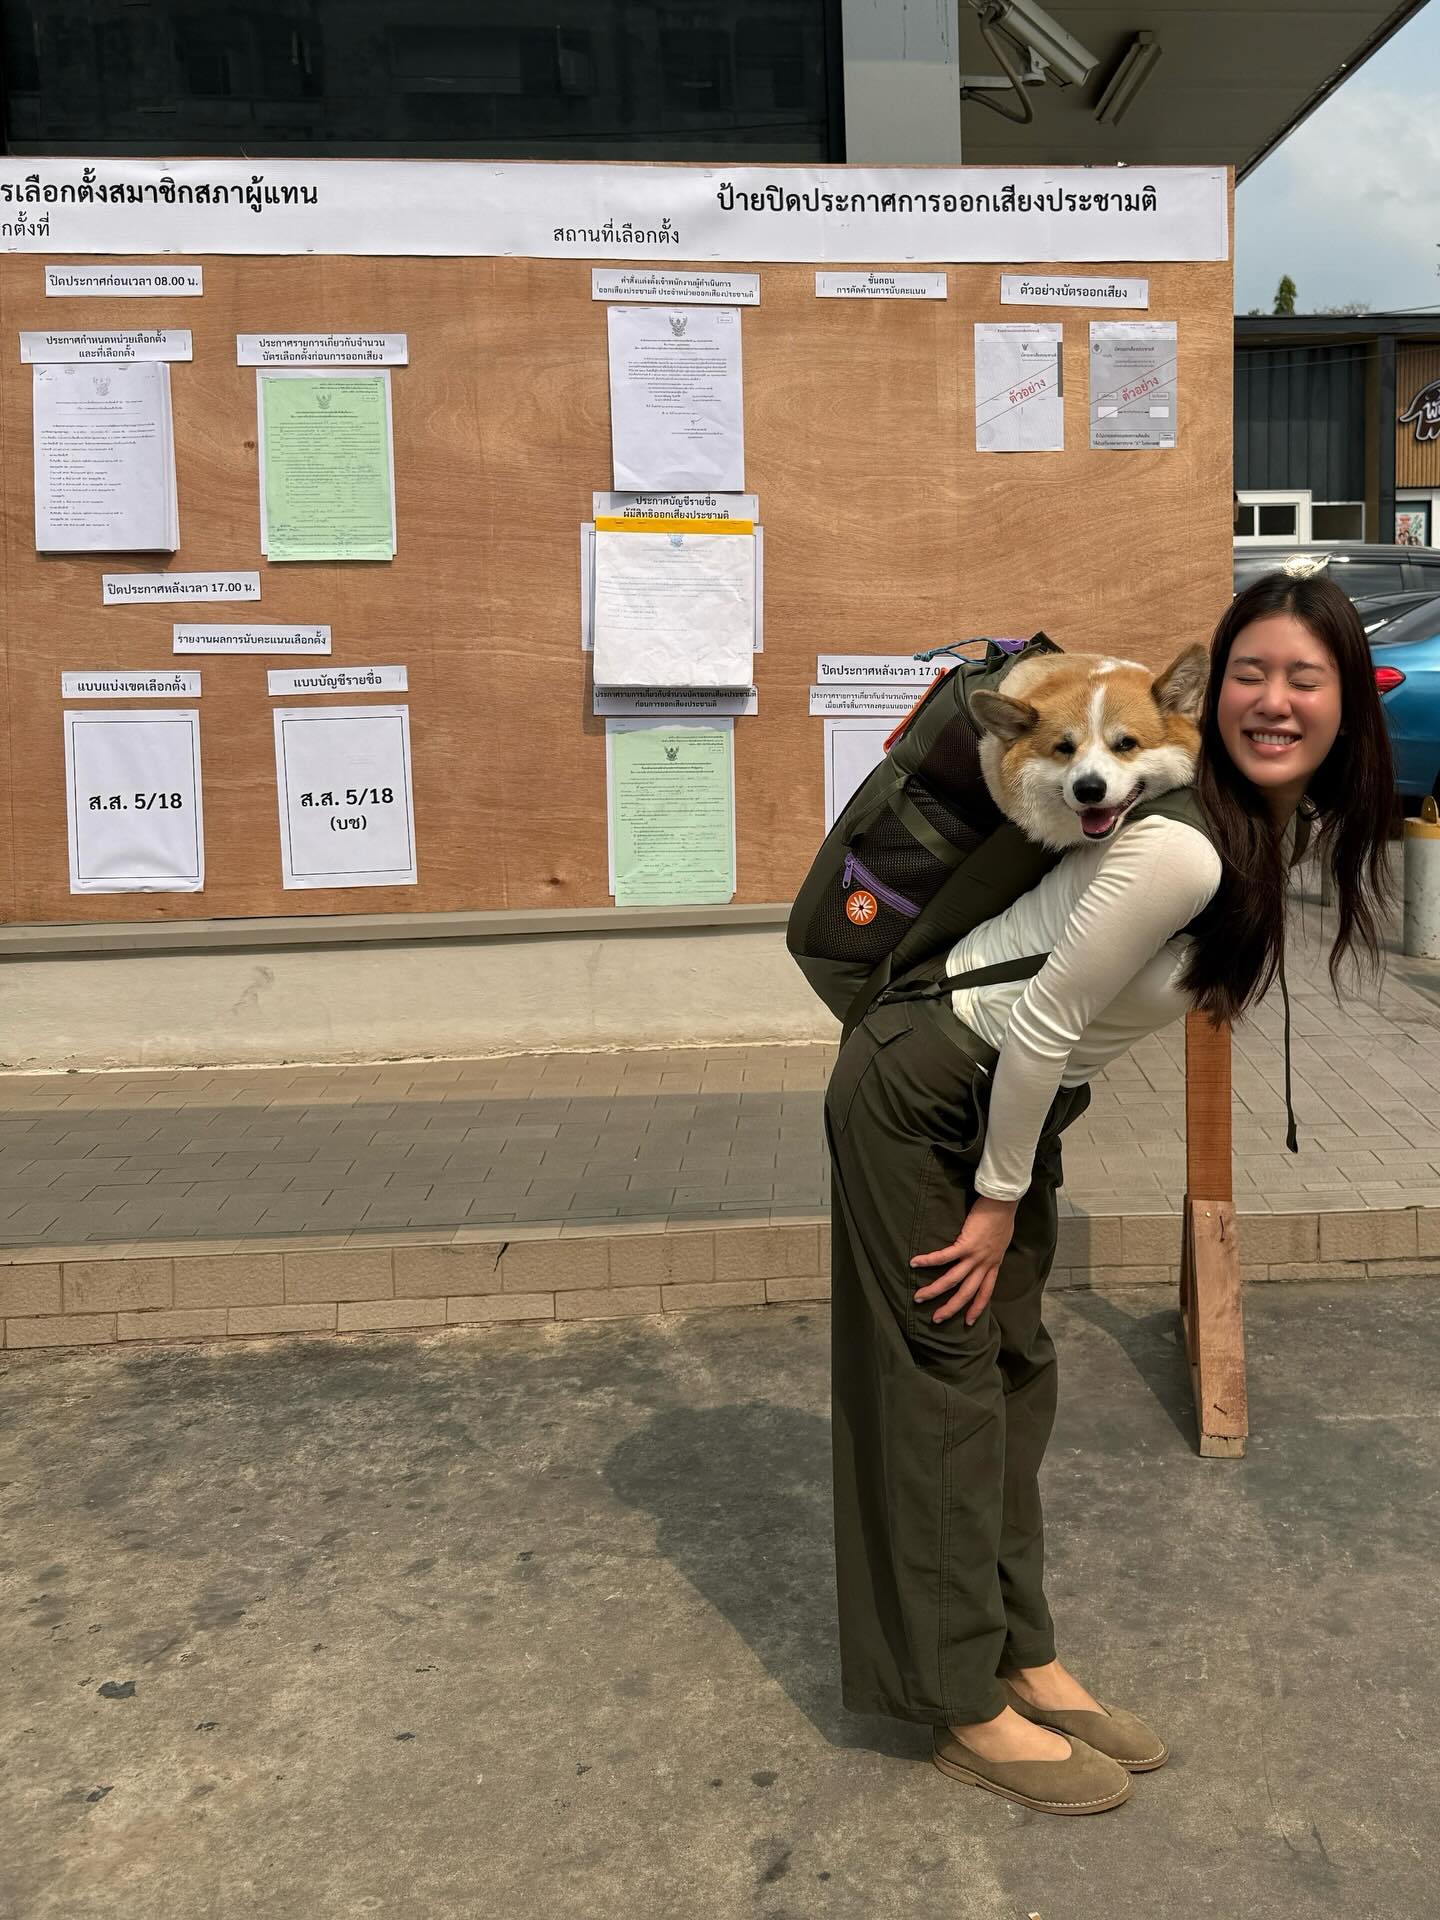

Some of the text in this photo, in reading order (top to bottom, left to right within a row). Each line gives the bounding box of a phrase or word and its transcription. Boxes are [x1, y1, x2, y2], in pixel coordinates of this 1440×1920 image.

[716, 182, 1158, 214] ป้ายปิดประกาศการออกเสียงประชามติ
[1, 210, 50, 237] กตั้งที่
[552, 217, 680, 246] สถานที่เลือกตั้ง
[49, 274, 199, 288] ปิดประกาศก่อนเวลา 08.00 น.
[867, 273, 895, 285] ขั้นตอน
[836, 285, 926, 295] การคัดค้านการนับคะแนน
[1020, 282, 1128, 299] ตัวอย่างบัตรออกเสียง
[46, 330, 167, 345] ประกาศกำหนดหน่วยเลือกตั้ง
[259, 335, 385, 348] ประกาศรายการเกี่ยวกับจำนวน
[79, 345, 135, 358] และที่เลือกตั้ง
[262, 348, 383, 361] บัตรเลือกตั้งก่อนการออกเสียง
[1008, 377, 1047, 405] ตัวอย่าง
[1121, 376, 1160, 402] ตัวอย่าง
[636, 493, 717, 508] ประกาศบัญชีรายชื่อ
[623, 508, 730, 520] ผ้มีสิทธิออกเสียงประชามติ
[108, 581, 256, 596] ปิดประกาศหลังเวลา 17.00 น.
[177, 631, 327, 646] รายงานผลการนับคะแนนเลือกตั้ง
[293, 667, 382, 688] แบบบัญชีรายชื่อ
[822, 664, 916, 676] ปิดประกาศหลังเวลา
[77, 674, 187, 693] แบบแบ่งเขตเลือกตั้ง
[88, 793, 182, 810] ส.ส. 5/18
[300, 787, 393, 807] ส.ส. 5/18
[330, 814, 367, 831] (บช)
